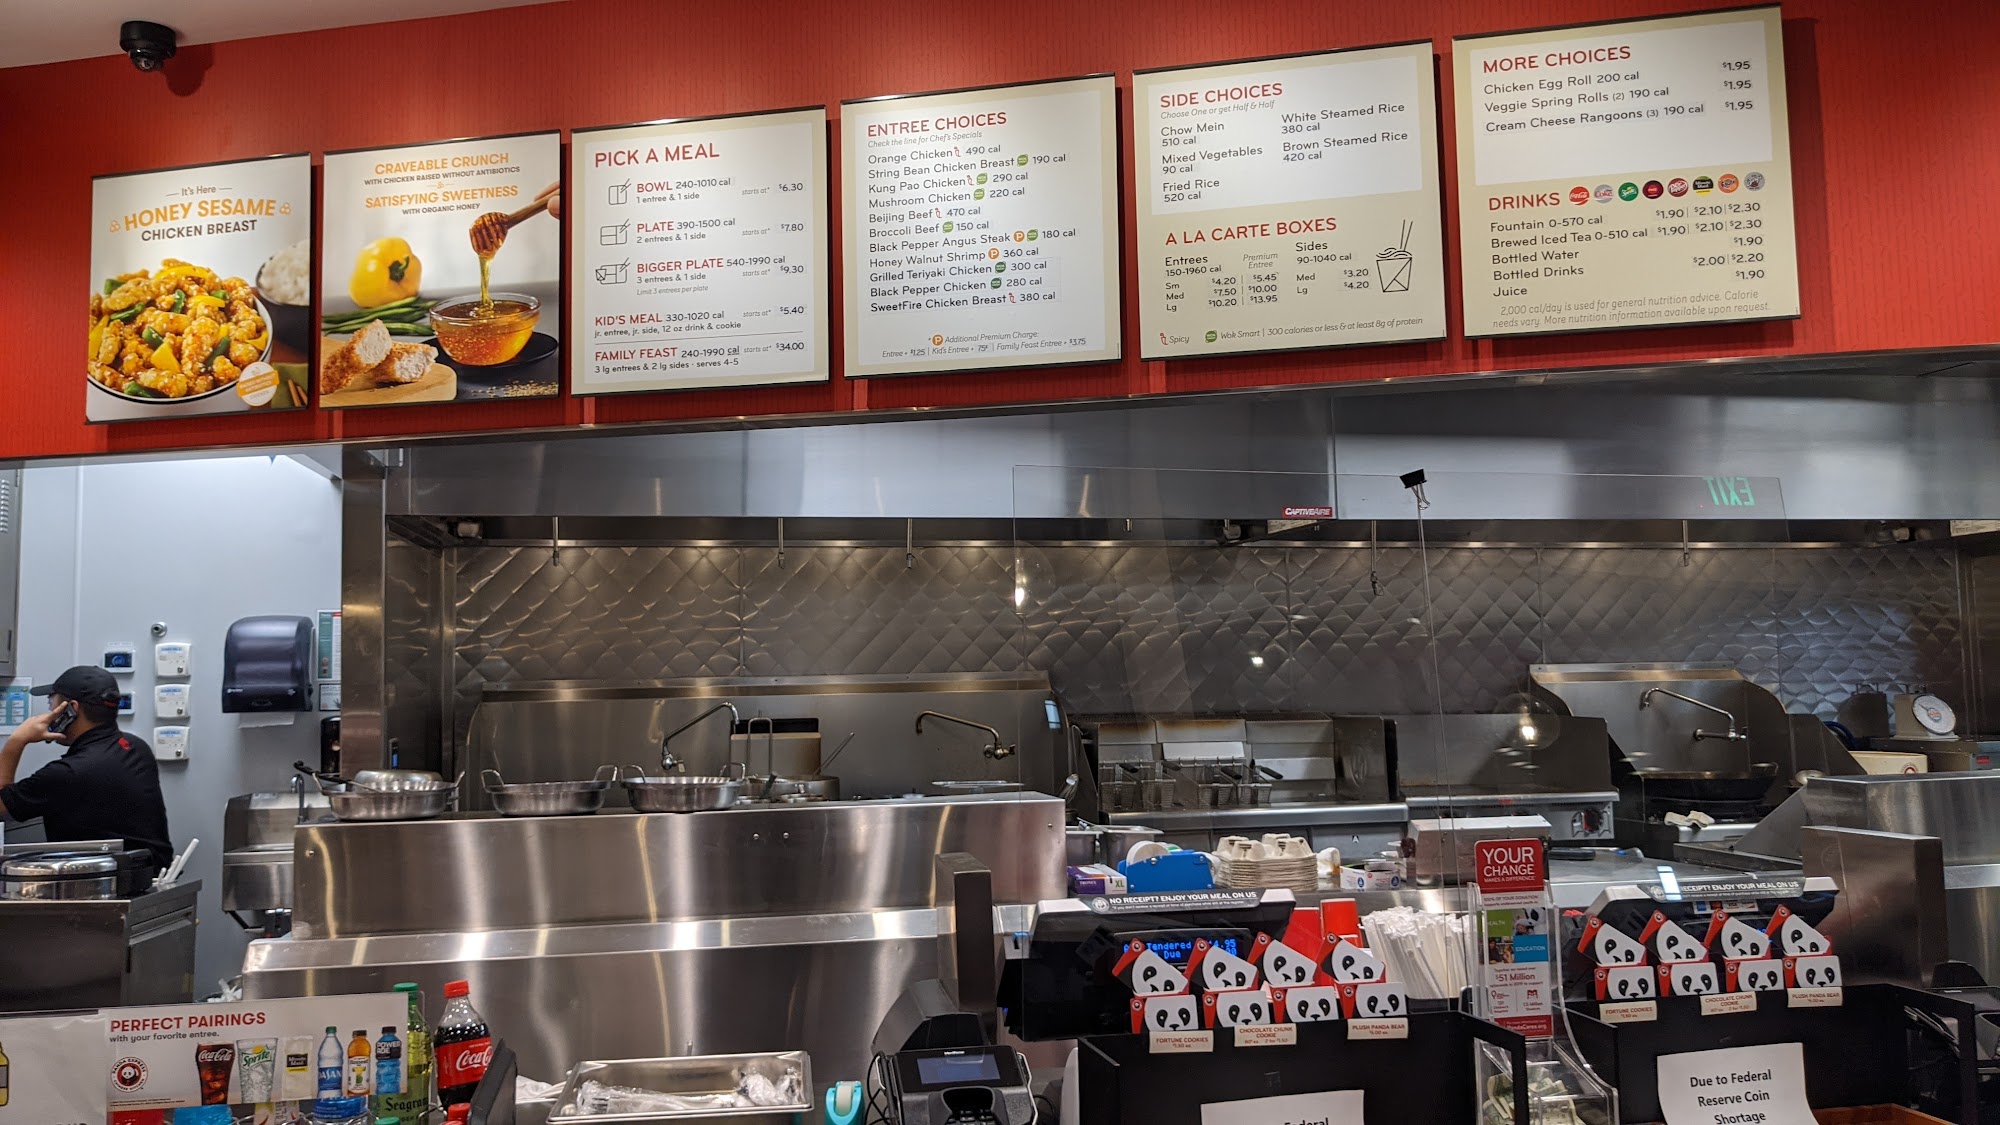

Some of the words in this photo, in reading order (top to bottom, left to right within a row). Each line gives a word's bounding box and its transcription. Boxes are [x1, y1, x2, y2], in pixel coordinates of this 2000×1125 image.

[1483, 56, 1539, 73] MORE
[1545, 46, 1631, 67] CHOICES
[1722, 61, 1750, 71] $1.95
[1484, 82, 1534, 94] Chicken
[1539, 79, 1562, 91] Egg
[1568, 76, 1591, 86] Roll
[1597, 73, 1620, 83] 200
[1624, 71, 1639, 81] cal
[1160, 92, 1199, 108] SIDE
[1205, 83, 1283, 103] CHOICES
[1484, 101, 1526, 113] Veggie
[1532, 96, 1572, 110] Spring
[1578, 92, 1608, 103] Rolls
[1630, 89, 1650, 99] 190
[1654, 88, 1668, 97] cal
[1282, 111, 1316, 123] White
[1321, 106, 1374, 120] Steamed
[1379, 103, 1405, 114] Rice
[868, 120, 929, 137] ENTREE
[935, 112, 1007, 130] CHOICES
[1161, 125, 1192, 136] Chow
[1196, 122, 1225, 132] Mein
[868, 140, 889, 148] Check
[917, 136, 928, 145] for
[952, 131, 982, 140] Specials
[1283, 140, 1319, 152] Brown
[1324, 134, 1377, 148] Steamed
[1382, 131, 1408, 142] Rice
[375, 158, 448, 174] CRAVEABLE
[452, 153, 508, 168] CRUNCH
[595, 150, 639, 167] PICK
[646, 148, 658, 162] A
[665, 143, 719, 161] MEAL
[868, 154, 906, 165] Orange
[910, 149, 952, 160] Chicken
[966, 147, 985, 155] 490
[988, 145, 1000, 153] cal
[1162, 152, 1196, 164] Mixed
[1199, 146, 1262, 161] Vegetables
[868, 169, 900, 179] String
[903, 166, 929, 176] Bean
[934, 162, 976, 172] Chicken
[980, 158, 1014, 169] Breast
[1033, 155, 1049, 164] 190
[1053, 154, 1066, 162] cal
[384, 175, 415, 184] CHICKEN
[416, 173, 440, 181] RAISED
[442, 170, 474, 179] WITHOUT
[476, 167, 520, 176] ANTIBIOTICS
[181, 187, 194, 196] It's
[197, 185, 216, 194] Here
[637, 182, 672, 192] BOWL
[676, 179, 716, 189] 240-1010
[719, 178, 730, 186] cal
[779, 183, 803, 192] $6.30
[1163, 181, 1190, 191] Fried
[1195, 178, 1220, 189] Rice
[366, 192, 439, 208] SATISFYING
[443, 185, 518, 202] SWEETNESS
[1489, 193, 1560, 211] DRINKS
[125, 201, 191, 231] HONEY
[198, 199, 276, 217] SESAME
[422, 205, 454, 213] ORGANIC
[456, 203, 480, 211] HONEY
[142, 224, 203, 241] CHICKEN
[207, 220, 257, 235] BREAST
[637, 221, 674, 233] PLATE
[677, 219, 720, 229] 390-1500
[723, 218, 735, 226] cal
[781, 223, 803, 232] $7.80
[1166, 233, 1177, 245] A
[1184, 230, 1205, 244] LA
[1211, 224, 1270, 241] CARTE
[1277, 217, 1336, 235] BOXES
[1490, 220, 1544, 232] Fountain
[1549, 217, 1584, 228] 0-570
[1588, 216, 1603, 225] cal
[869, 243, 897, 252] Black
[901, 240, 938, 252] Pepper
[942, 236, 976, 248] Angus
[980, 233, 1010, 243] Steak
[1042, 230, 1059, 238] 180
[1063, 229, 1076, 237] cal
[1296, 241, 1327, 252] Sides
[637, 261, 682, 273] BIGGER
[686, 258, 723, 269] PLATE
[726, 257, 770, 266] 540-1990
[773, 256, 785, 264] cal
[869, 258, 902, 269] Honey
[906, 254, 943, 265] Walnut
[947, 252, 985, 264] Shrimp
[1003, 249, 1022, 257] 360
[1025, 248, 1038, 256] cal
[1165, 255, 1208, 267] Entrees
[1492, 252, 1537, 265] Bottled
[1541, 250, 1579, 261] Water
[780, 265, 804, 274] $9.30
[595, 350, 636, 361] FAMILY
[640, 348, 677, 359] FEAST
[681, 348, 724, 358] 240-1990
[727, 346, 739, 355] cal
[776, 342, 804, 351] $34.00
[1483, 847, 1533, 864] YOUR
[1484, 864, 1535, 876] CHANGE
[1115, 880, 1124, 888] XL
[1124, 895, 1158, 903] RECEIPT?
[1164, 950, 1181, 959] Due
[111, 1017, 182, 1032] PERFECT
[188, 1012, 265, 1028] PAIRINGS
[109, 1034, 128, 1042] with
[130, 1034, 150, 1043] your
[153, 1032, 187, 1040] favorite
[243, 1047, 270, 1067] Sprite
[1690, 1076, 1713, 1087] Due
[1716, 1075, 1728, 1085] to
[1731, 1069, 1771, 1083] Federal
[1698, 1095, 1742, 1107] Reserve
[1745, 1090, 1769, 1102] Coin
[1715, 1111, 1766, 1125] Shortage
